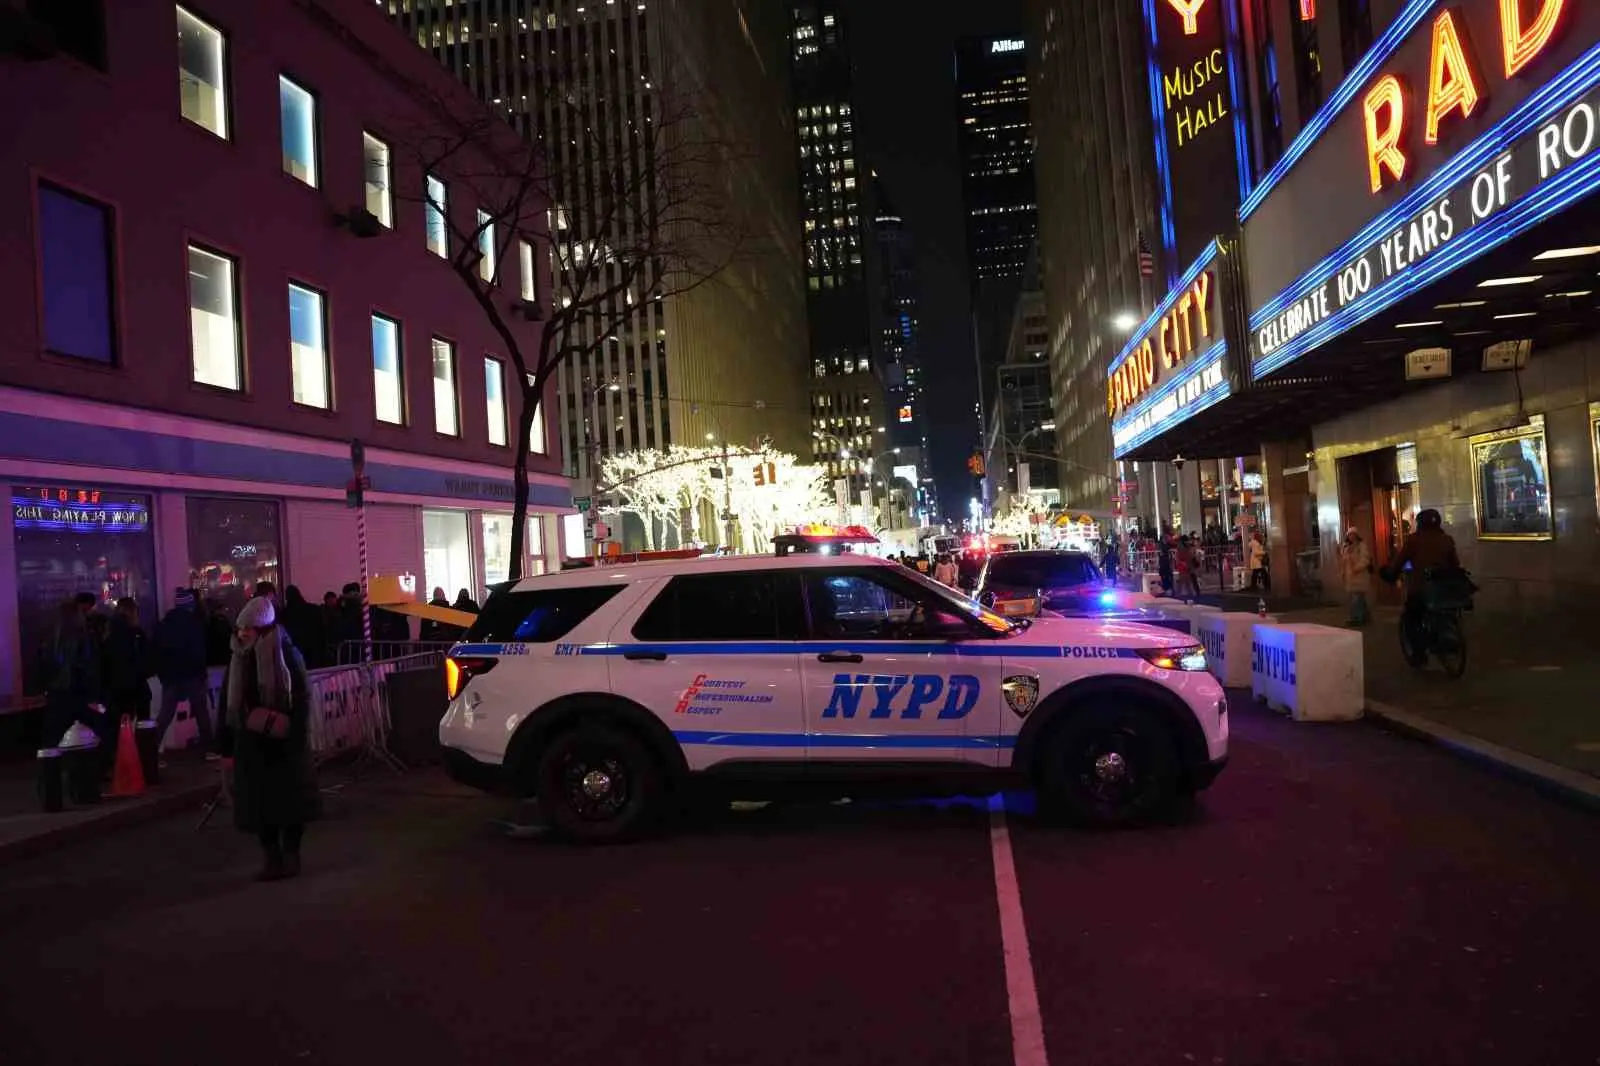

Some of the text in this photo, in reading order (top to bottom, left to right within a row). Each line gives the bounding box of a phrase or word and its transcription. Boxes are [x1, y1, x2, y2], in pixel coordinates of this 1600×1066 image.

[1164, 49, 1223, 110] MUSIC
[1363, 0, 1564, 194] RAD
[1176, 92, 1228, 147] HALL
[1259, 103, 1600, 355] CELEBRATE 100 YEARS OF RO
[1114, 336, 1154, 411] RADIO
[1160, 271, 1209, 370] CITY
[1062, 646, 1119, 658] POLICE
[1257, 643, 1289, 682] NYPD
[821, 673, 981, 719] NYPD
